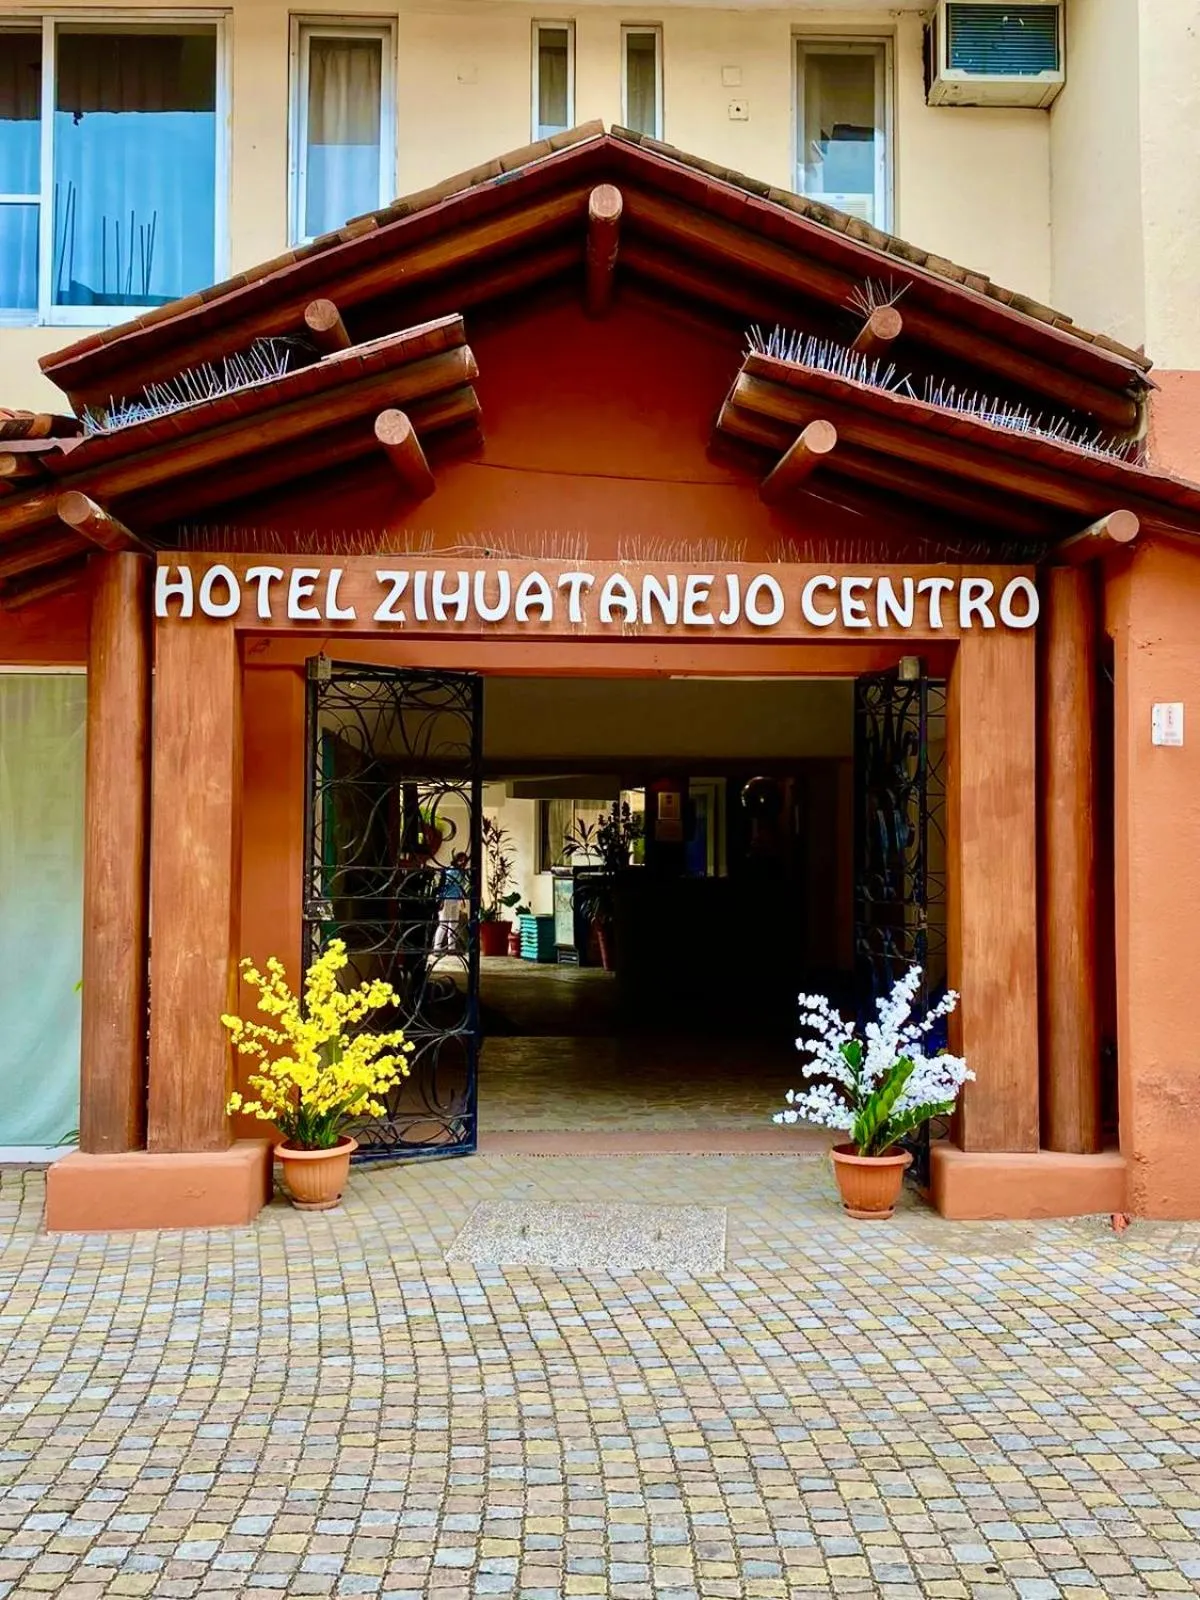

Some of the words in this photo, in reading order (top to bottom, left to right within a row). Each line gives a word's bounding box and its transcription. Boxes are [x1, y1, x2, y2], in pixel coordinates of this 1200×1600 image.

[155, 565, 357, 621] HOTEL
[373, 570, 785, 627] ZIHUATANEJO
[801, 575, 1040, 629] CENTRO
